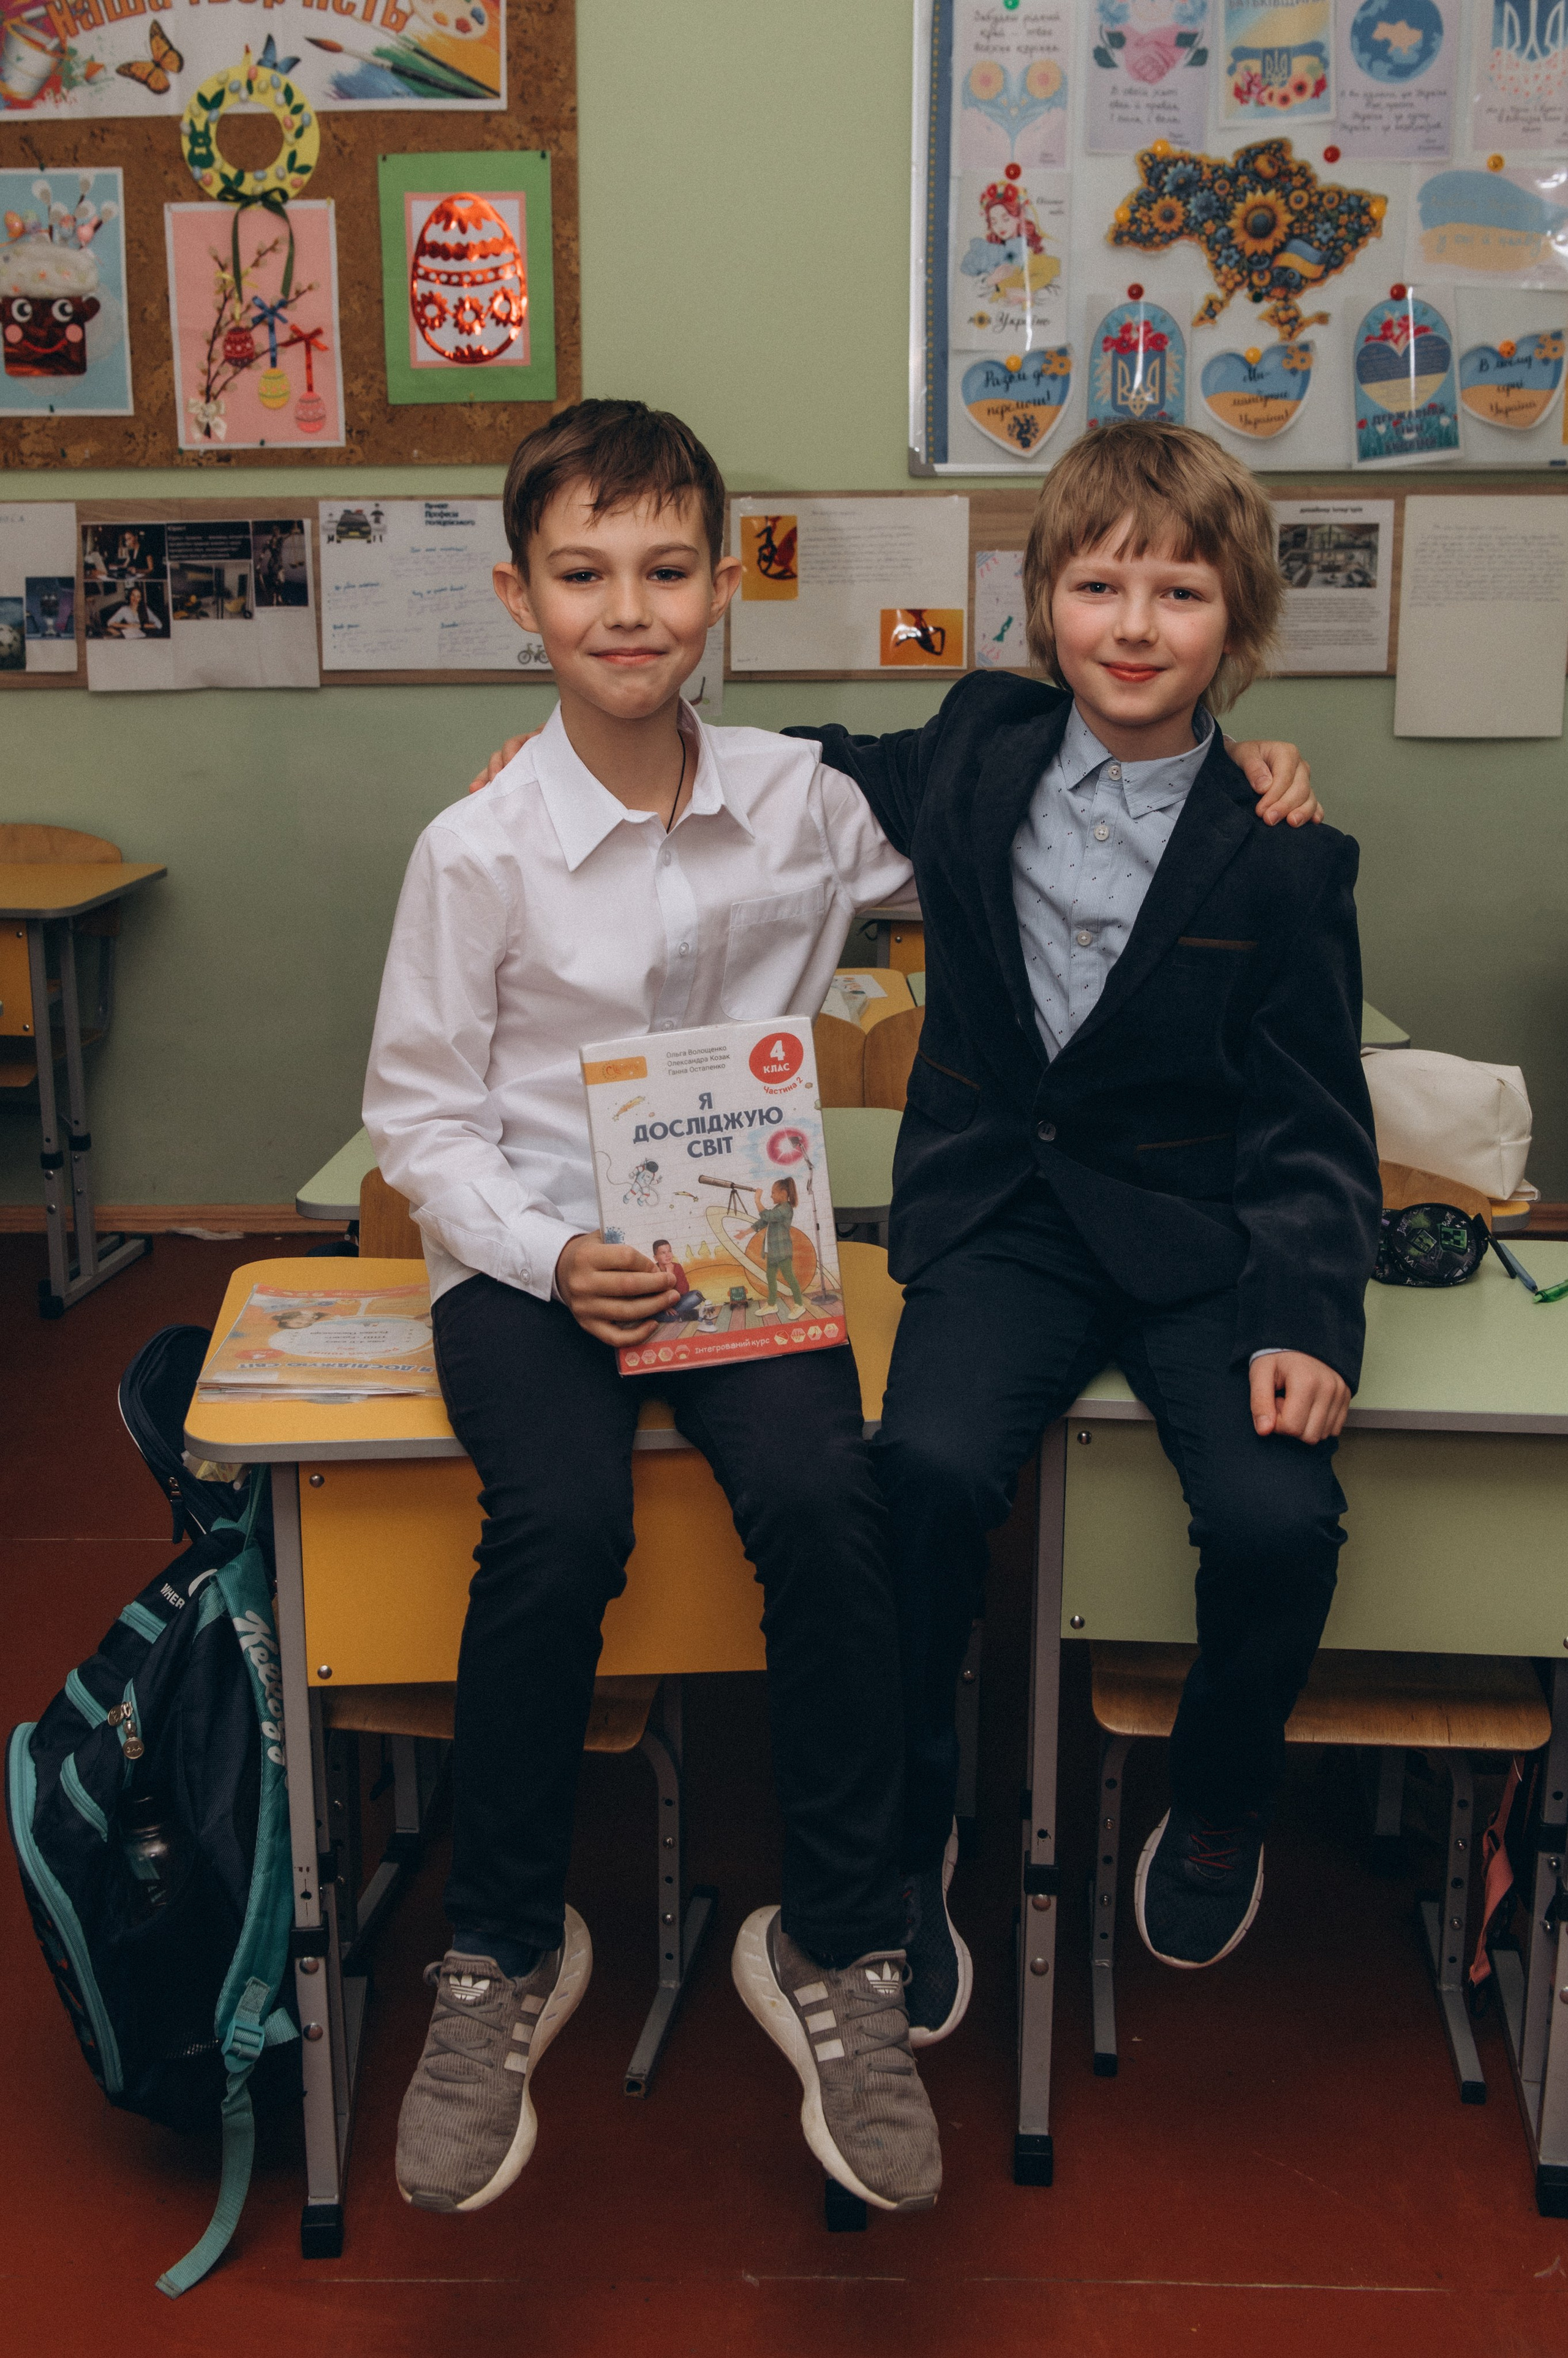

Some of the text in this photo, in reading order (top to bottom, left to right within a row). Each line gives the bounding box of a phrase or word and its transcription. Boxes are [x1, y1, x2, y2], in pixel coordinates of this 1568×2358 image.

[688, 1046, 727, 1056] Волощенко
[769, 1040, 785, 1061] 4
[667, 1056, 709, 1067] Олександра
[689, 1064, 726, 1073] Остапенко
[763, 1063, 790, 1073] КЛАС
[763, 1083, 797, 1094] Частина
[698, 1092, 713, 1110] Я
[633, 1106, 783, 1144] ДОСЛІДЖУЮ
[687, 1136, 733, 1158] СВІТ
[695, 1338, 770, 1354] Інтегрований курс
[287, 1362, 415, 1372] ДОСЛІДЖУЮ
